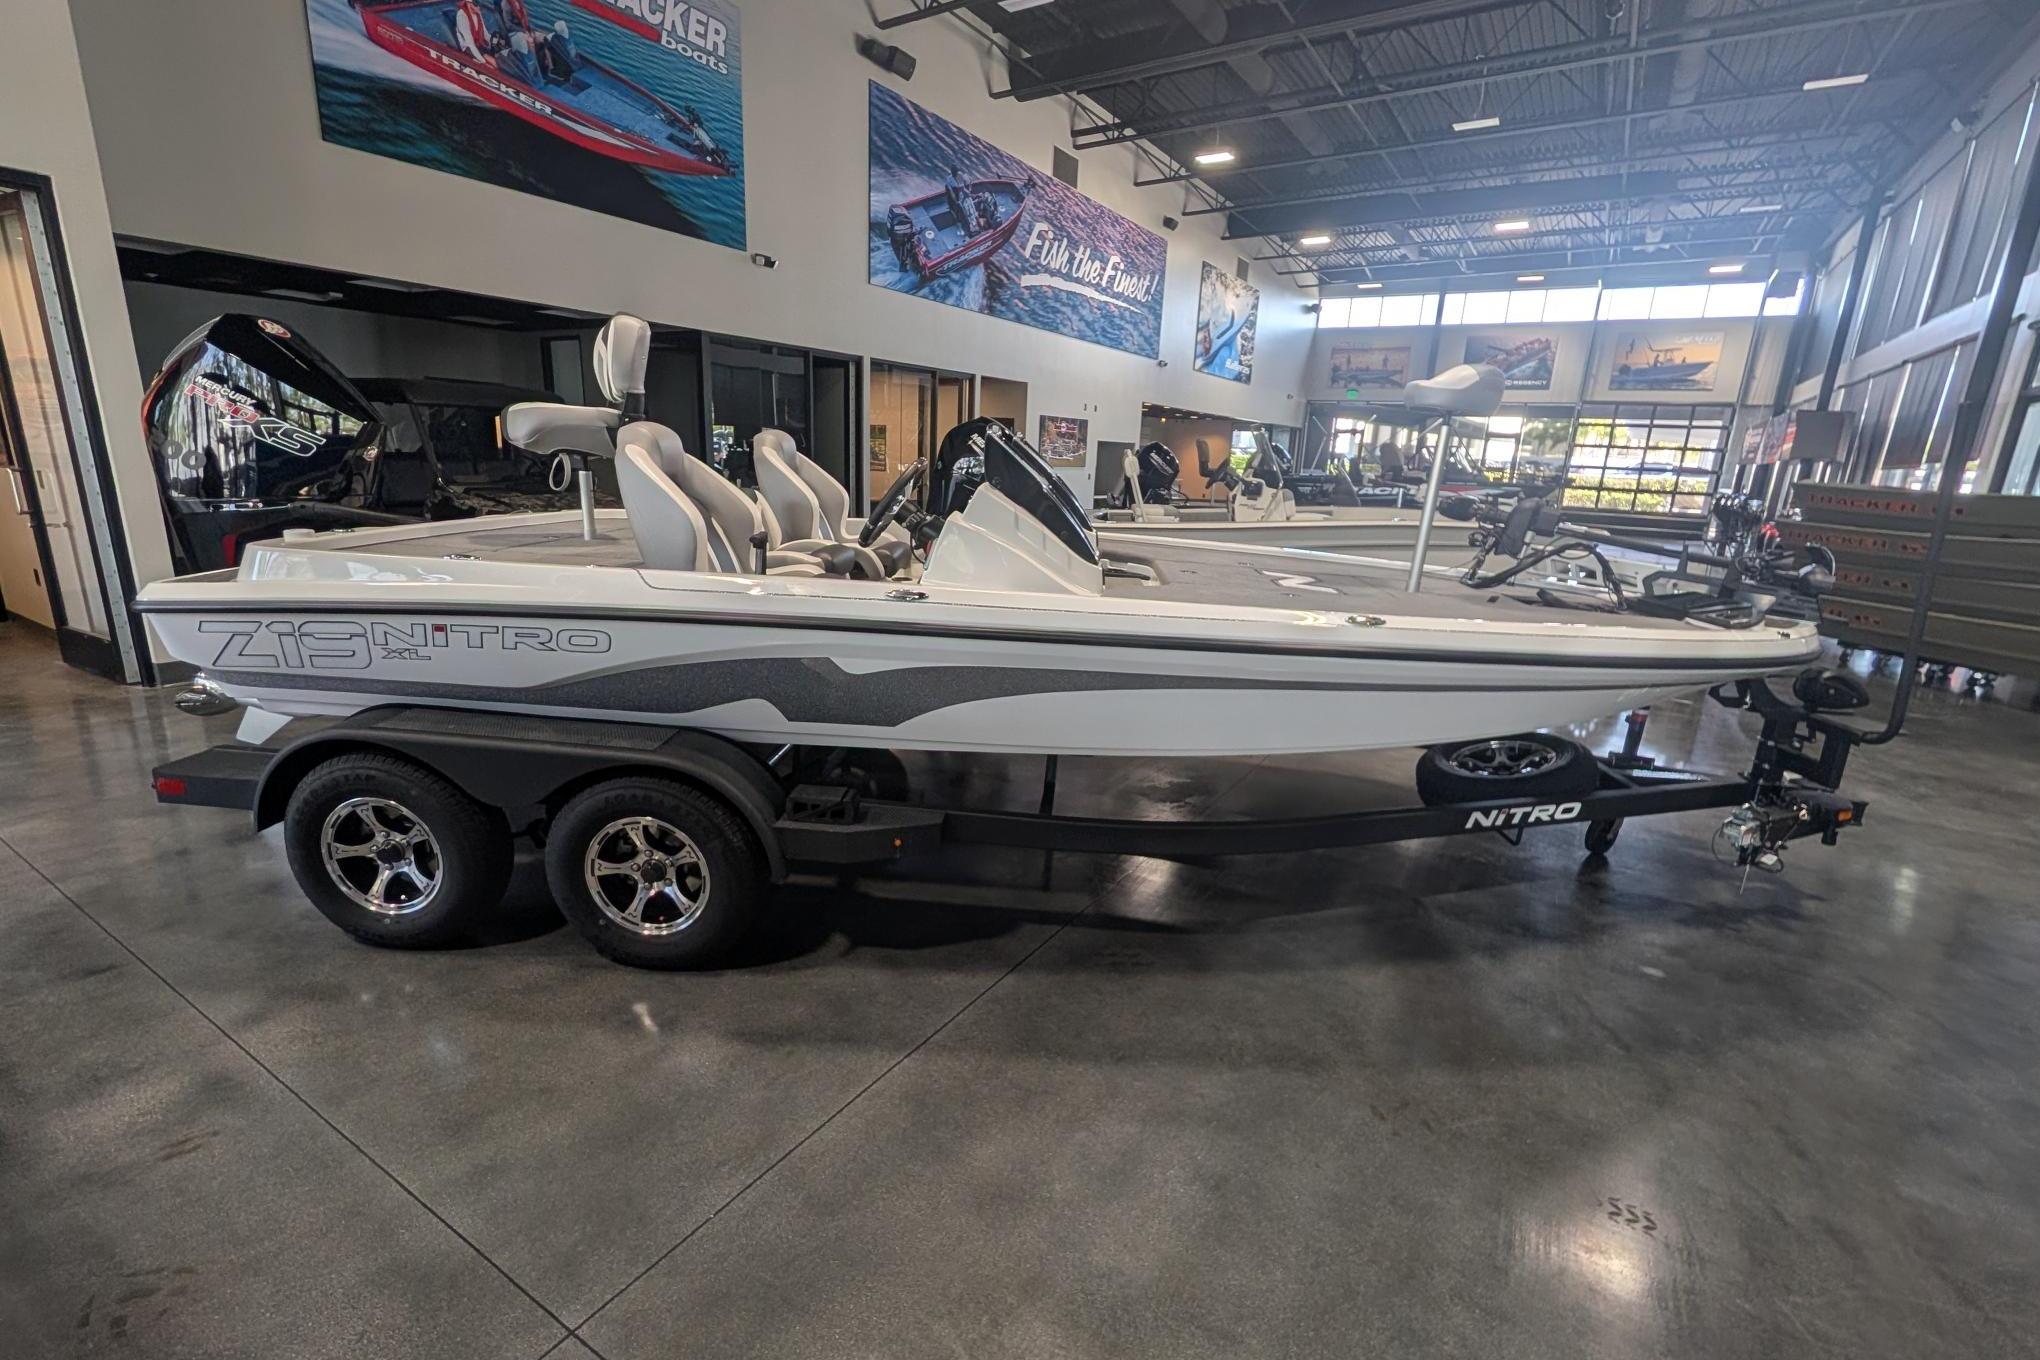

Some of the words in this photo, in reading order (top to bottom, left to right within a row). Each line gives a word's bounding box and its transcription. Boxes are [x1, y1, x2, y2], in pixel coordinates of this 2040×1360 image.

[661, 31, 728, 75] boats
[427, 47, 552, 115] TRACKER
[1024, 222, 1070, 274] Fish
[1072, 245, 1101, 284] the
[1102, 255, 1159, 302] Finest!
[184, 383, 260, 423] PRO
[194, 375, 257, 405] MERCURY
[217, 417, 327, 457] XS
[198, 620, 371, 670] Z19
[371, 622, 612, 654] NITRO
[380, 648, 431, 661] XL
[1464, 801, 1582, 830] NITRO
